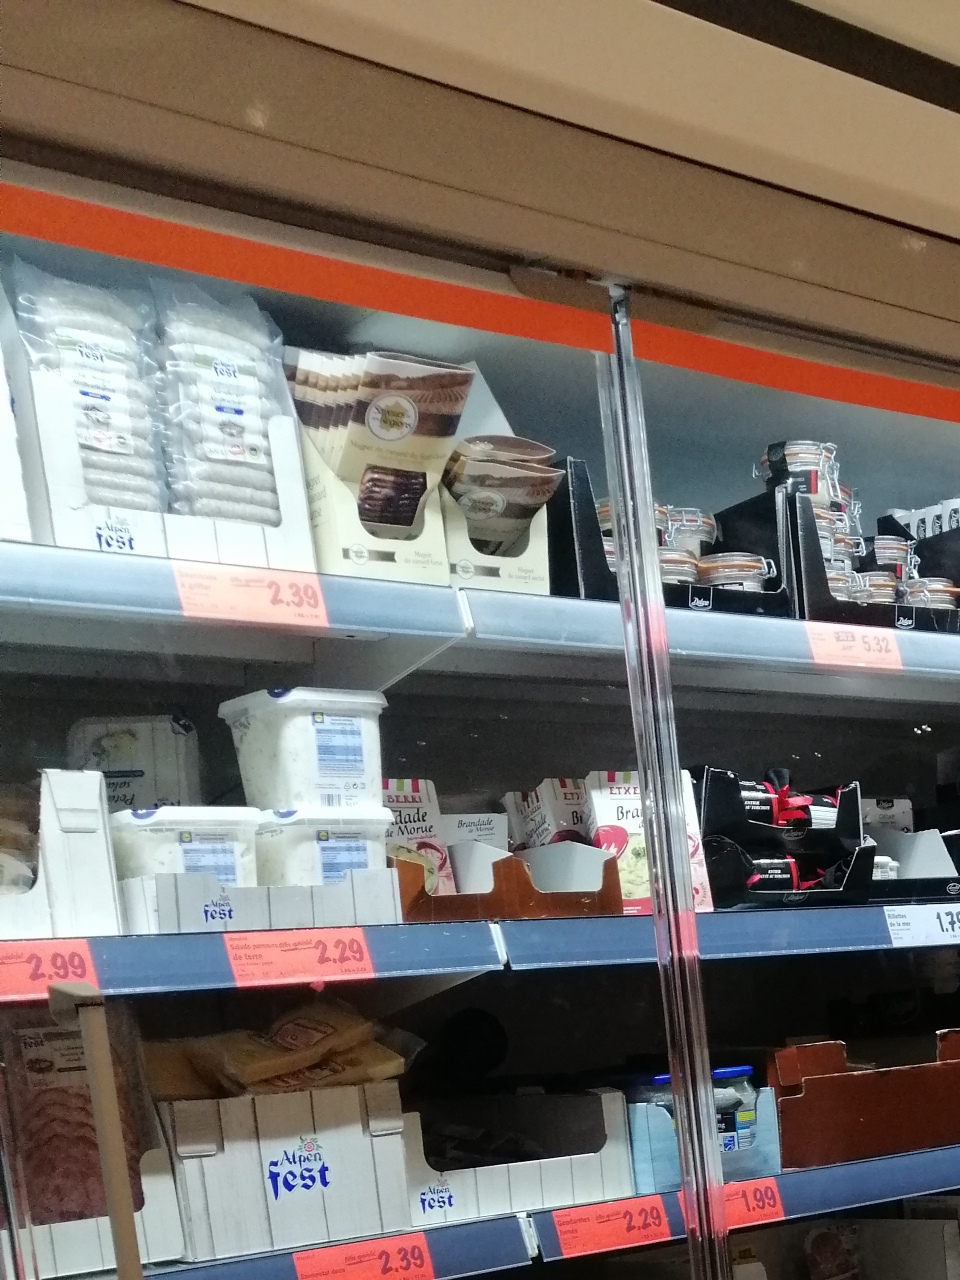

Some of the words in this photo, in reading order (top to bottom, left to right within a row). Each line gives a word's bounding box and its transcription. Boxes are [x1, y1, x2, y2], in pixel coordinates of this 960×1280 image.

[96, 527, 135, 551] fest
[267, 580, 320, 609] 2.39
[861, 634, 893, 654] 5.32
[387, 794, 423, 804] BERRI
[609, 786, 640, 795] ETXE
[397, 824, 435, 836] Morue
[457, 818, 494, 829] Brandade
[203, 904, 234, 922] fest
[314, 938, 364, 966] 2.29
[27, 952, 87, 981] 2.99
[280, 1148, 323, 1166] Alpen
[267, 1160, 332, 1202] fest
[425, 1184, 450, 1195] Alpen
[420, 1191, 454, 1214] fest
[741, 1185, 777, 1213] 1.99
[622, 1205, 662, 1233] 2.29
[377, 1244, 425, 1276] 2.39
